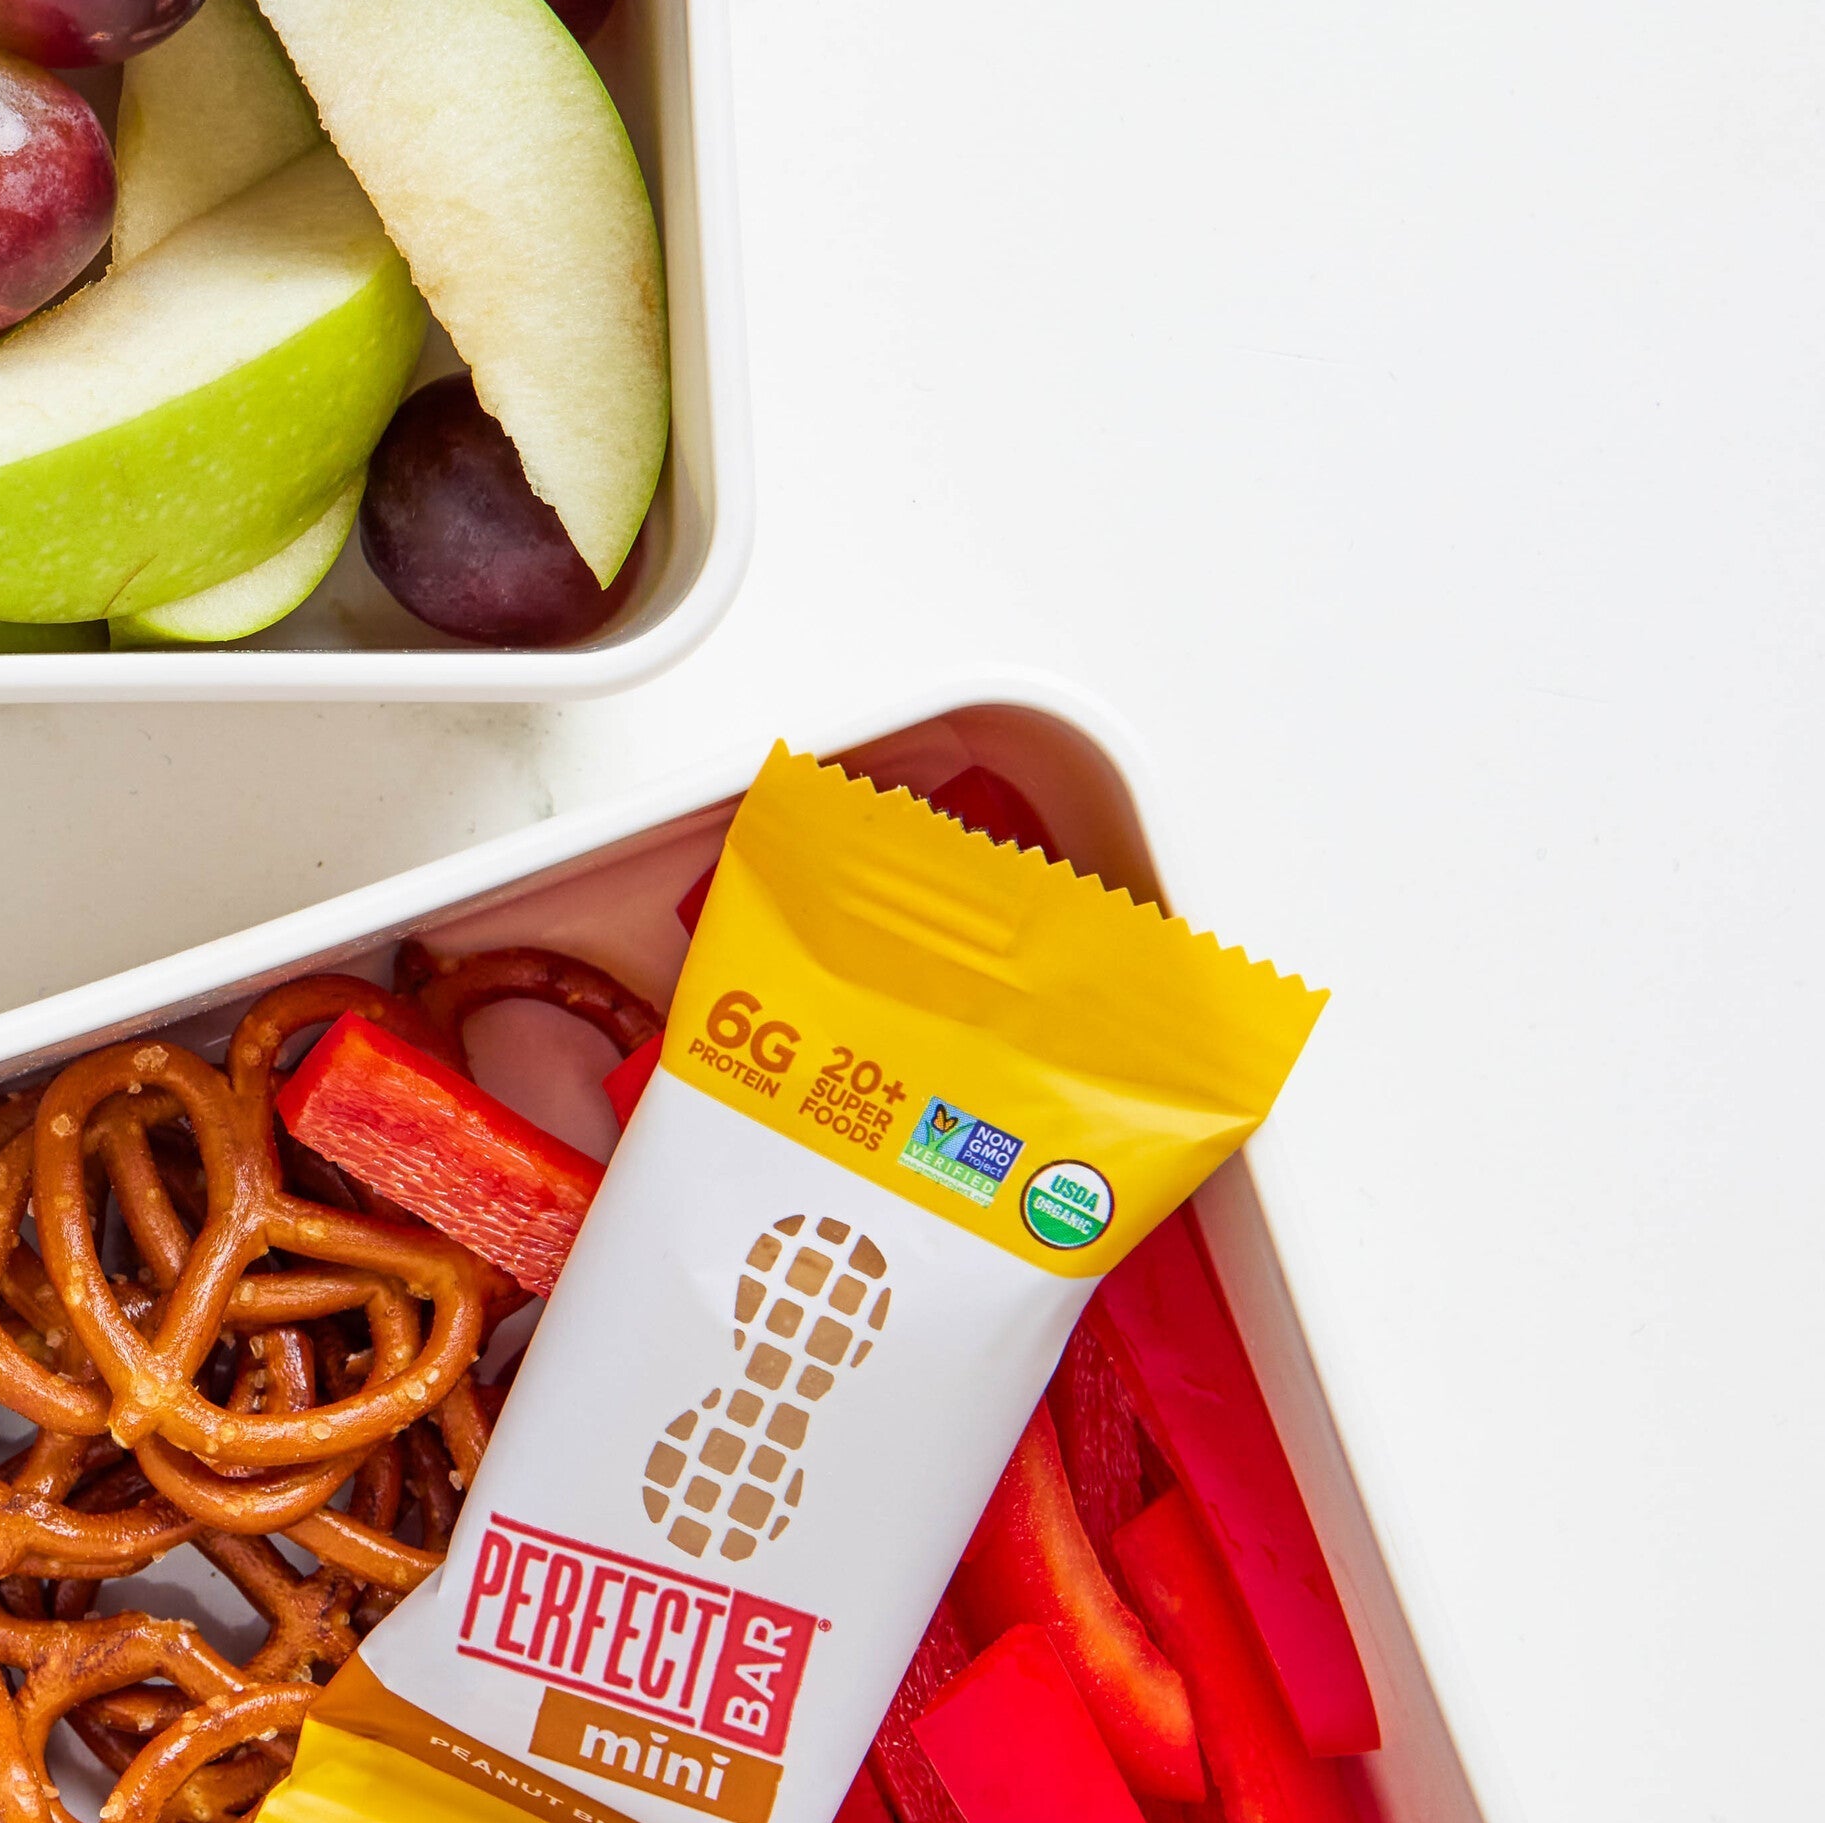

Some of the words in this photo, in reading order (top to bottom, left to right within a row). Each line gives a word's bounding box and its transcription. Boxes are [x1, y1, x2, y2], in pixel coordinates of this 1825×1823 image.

[706, 990, 802, 1074] 6G
[688, 1037, 781, 1098] PROTEIN
[820, 1046, 907, 1106] 20+
[798, 1096, 883, 1152] FOODS
[811, 1077, 893, 1133] SUPER
[962, 1150, 1004, 1178] Project
[968, 1139, 1010, 1167] GMO
[976, 1126, 1017, 1155] NON
[912, 1144, 995, 1195] VERIFIED
[1049, 1174, 1100, 1213] USDA
[1033, 1195, 1094, 1235] ORGANIC
[459, 1528, 727, 1710] PERFECT
[722, 1615, 793, 1737] BAR
[430, 1736, 564, 1807] PEANUT
[579, 1724, 731, 1801] mini
